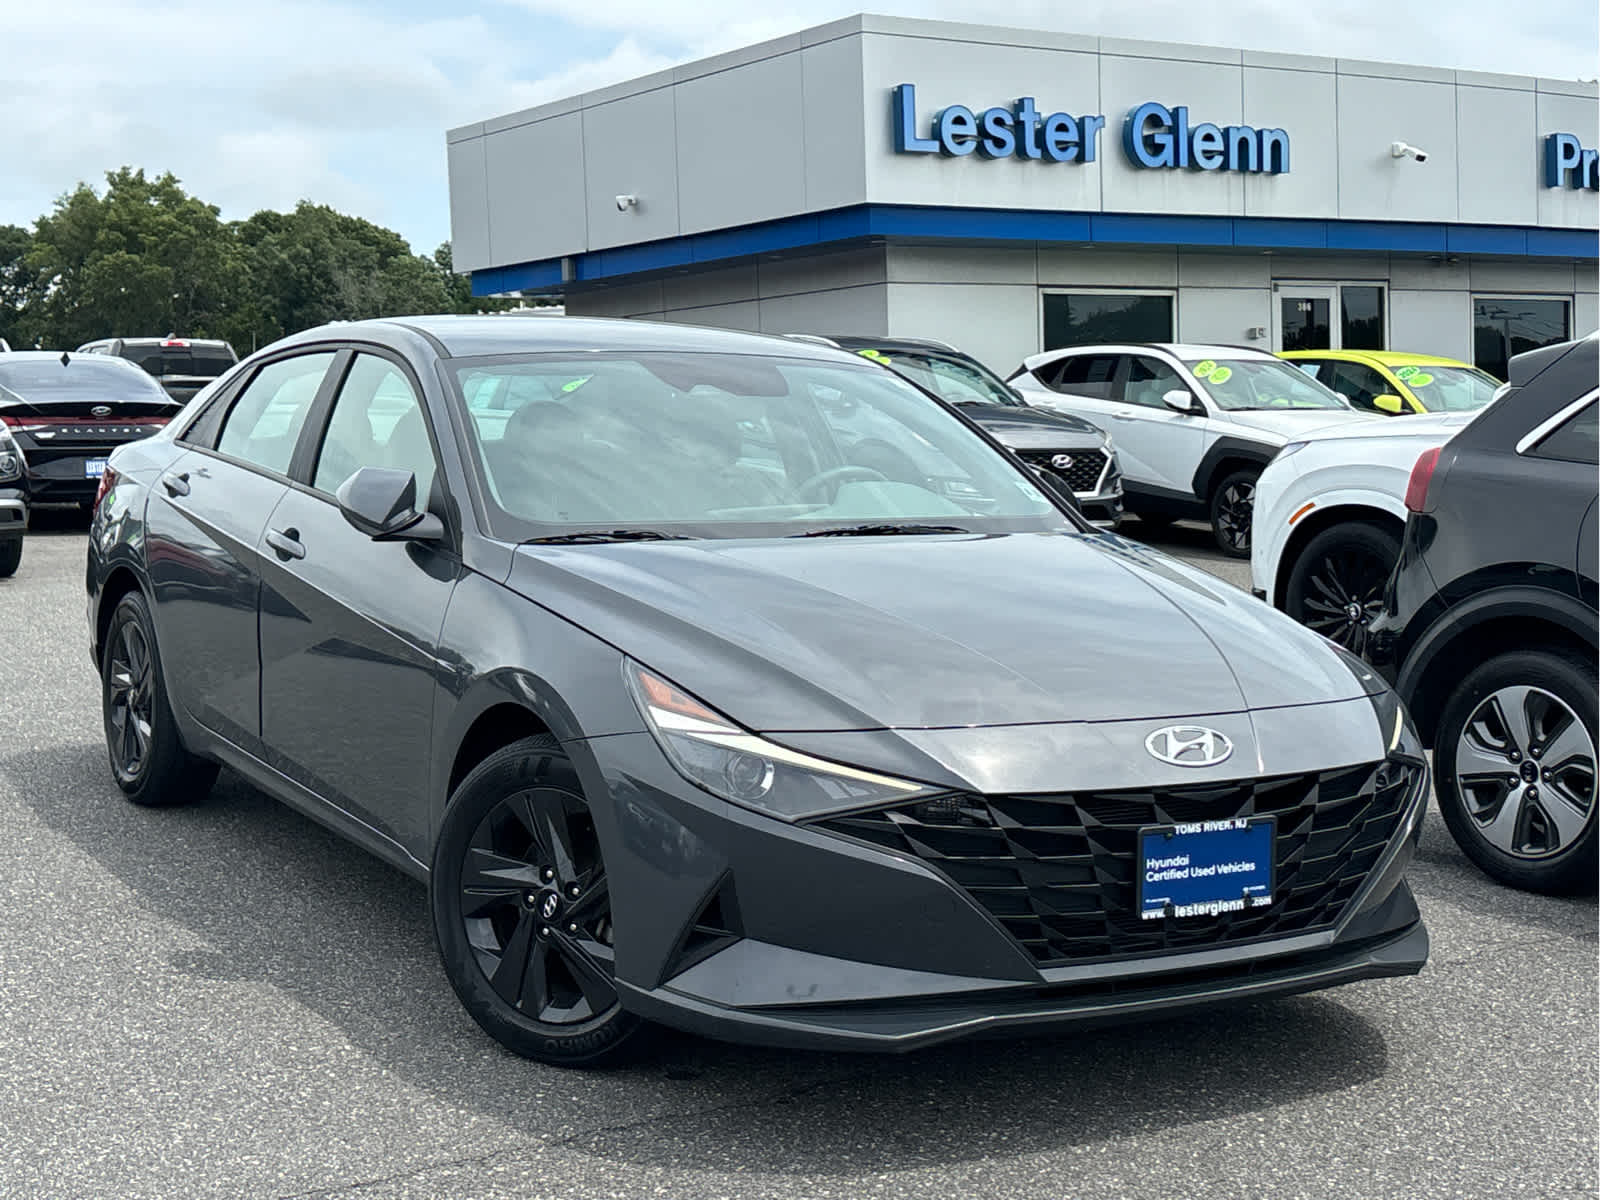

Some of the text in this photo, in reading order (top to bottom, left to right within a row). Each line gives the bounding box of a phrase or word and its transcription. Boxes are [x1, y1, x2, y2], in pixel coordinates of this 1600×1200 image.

[892, 83, 1290, 175] Lester Glenn
[1545, 133, 1599, 190] Pr
[1174, 823, 1202, 836] TOMS
[1235, 818, 1248, 830] NJ
[1145, 861, 1256, 883] Certified Used Vehicles
[1146, 854, 1190, 870] Hyundai
